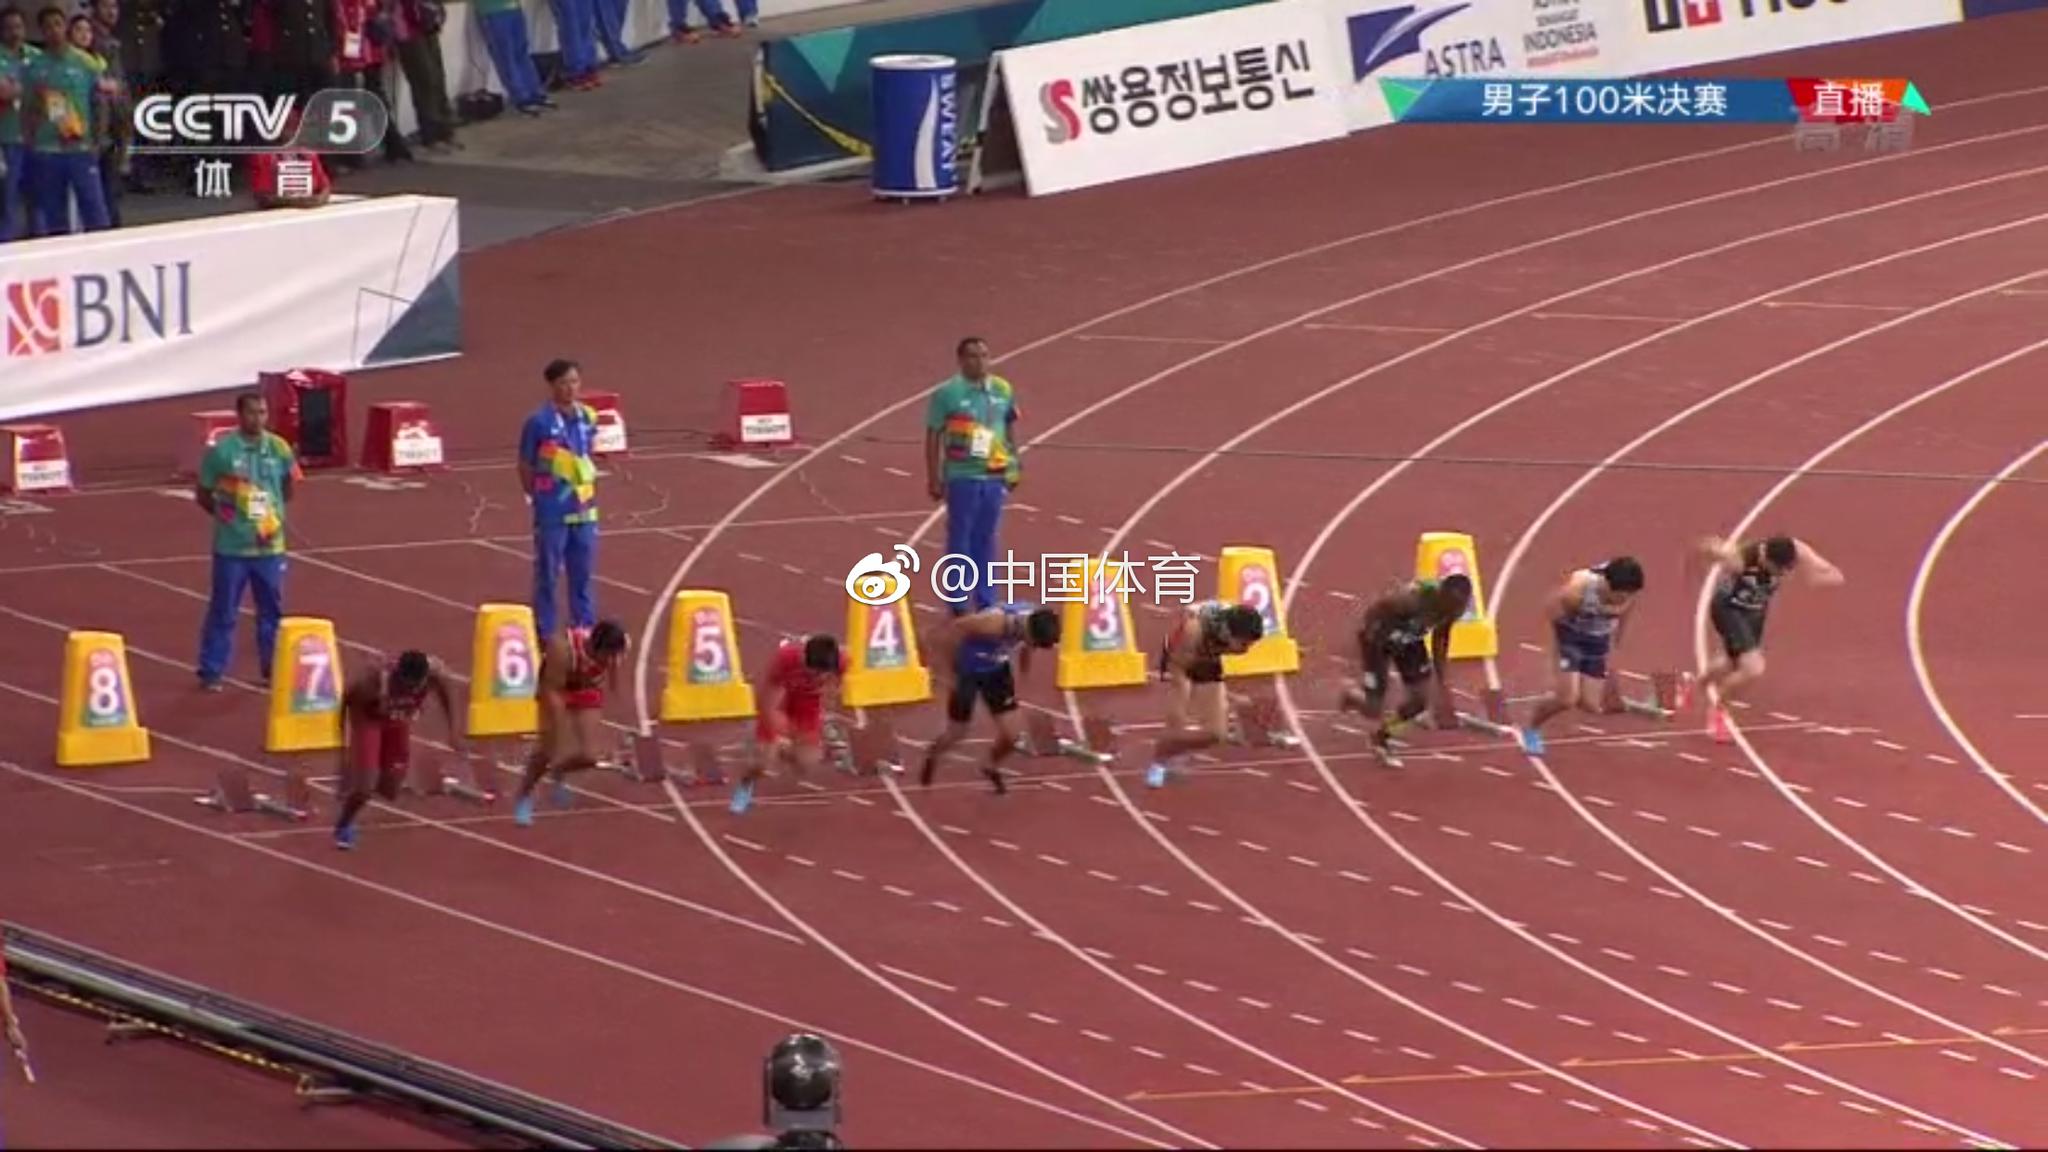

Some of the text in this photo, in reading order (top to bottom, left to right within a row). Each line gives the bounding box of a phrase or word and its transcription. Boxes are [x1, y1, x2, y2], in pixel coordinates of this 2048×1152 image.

[1424, 36, 1506, 78] ASTRA
[1523, 22, 1598, 52] INDONESIA
[1081, 39, 1315, 135] 쌍용정보통신
[72, 261, 192, 349] BNI
[870, 609, 900, 658] 4
[1088, 586, 1118, 640] 3
[499, 639, 529, 688] 6
[694, 625, 724, 673] 5
[89, 666, 121, 716] 8
[299, 652, 330, 701] 7
